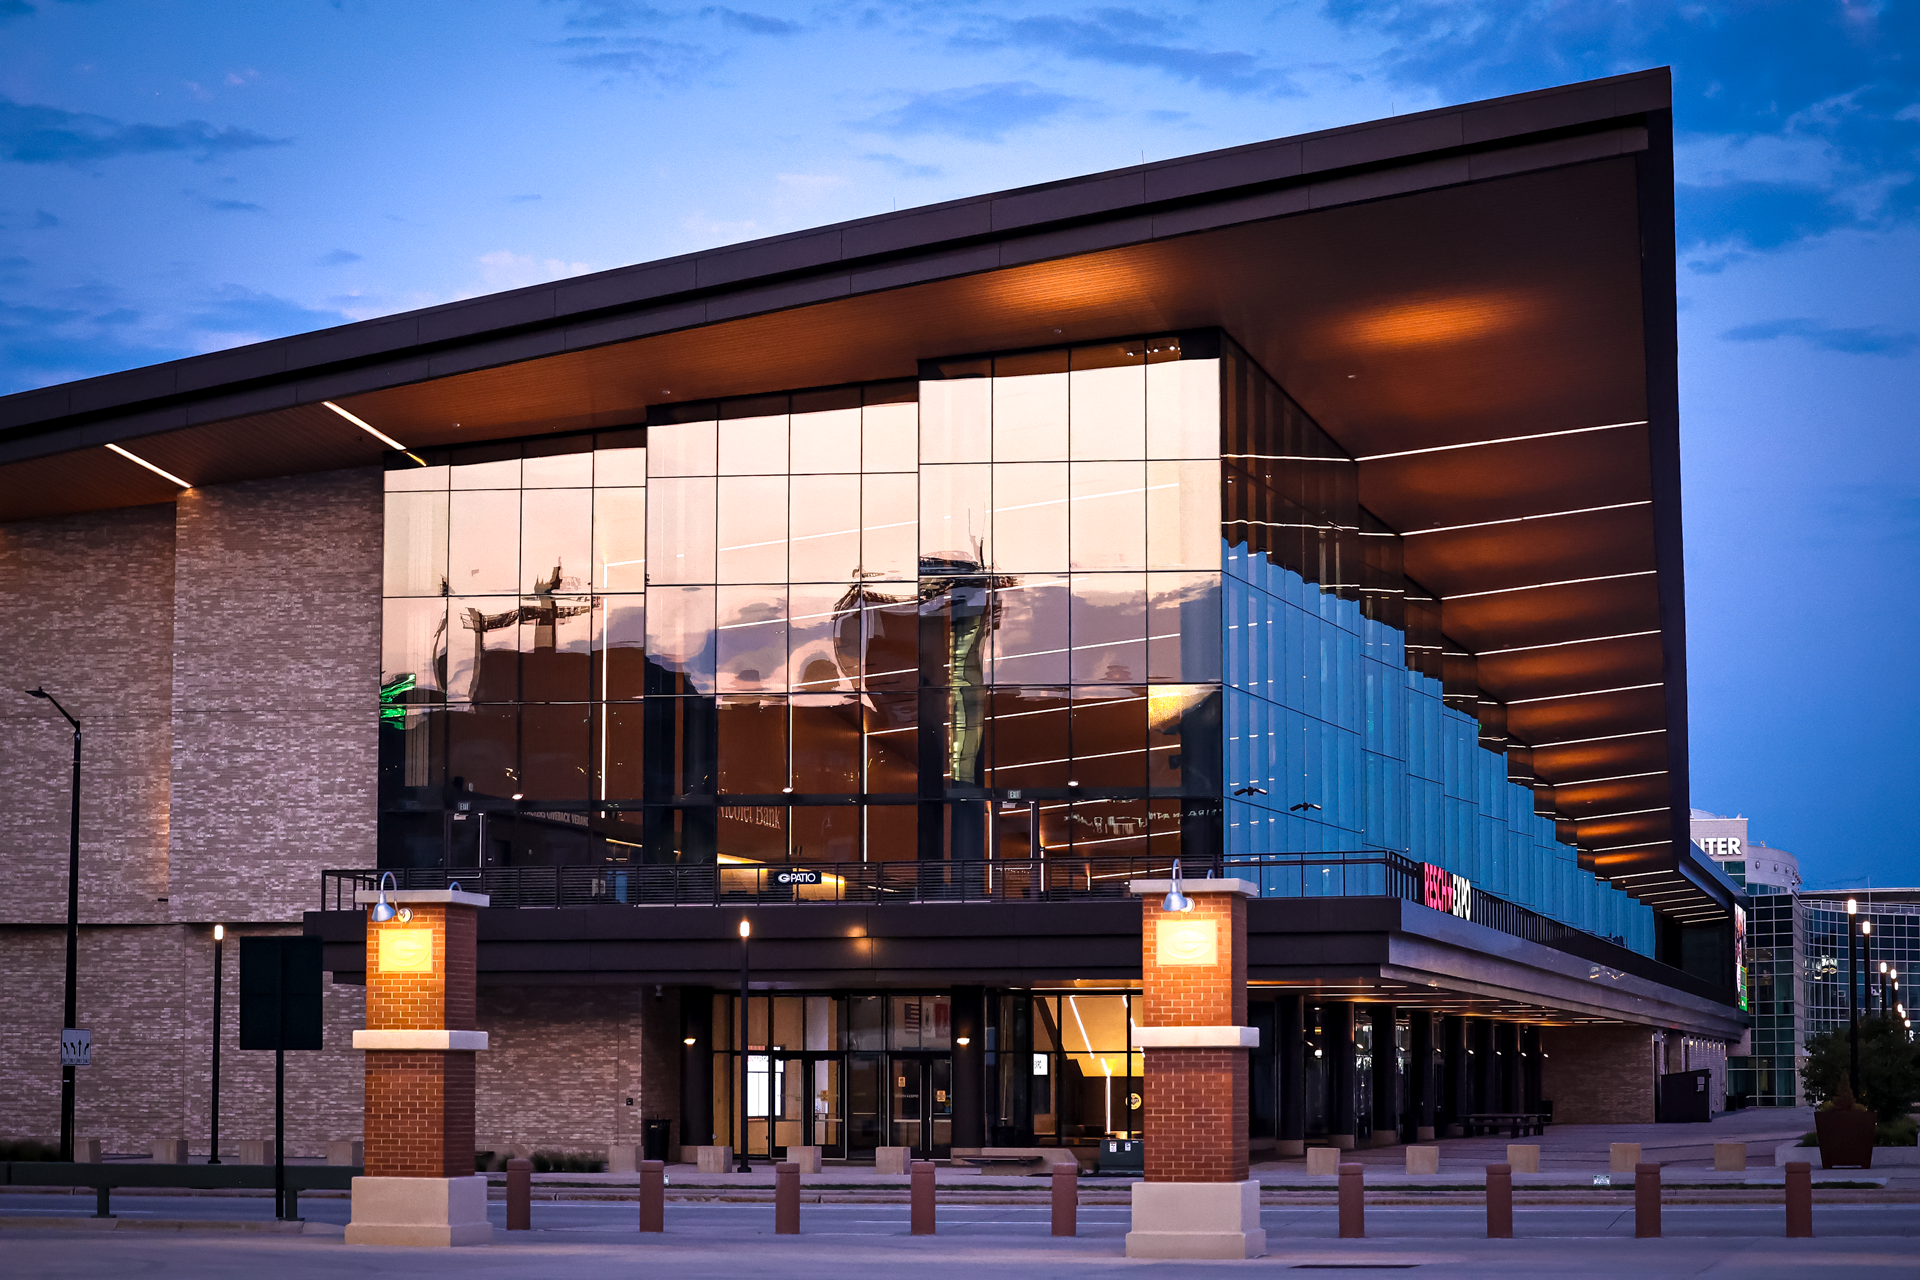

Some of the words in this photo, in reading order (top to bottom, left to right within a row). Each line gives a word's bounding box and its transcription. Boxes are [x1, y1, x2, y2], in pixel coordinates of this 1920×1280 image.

[755, 806, 781, 829] Bank
[791, 873, 816, 883] PATIO
[1424, 861, 1448, 913] RESCH
[1452, 873, 1471, 921] EXPO
